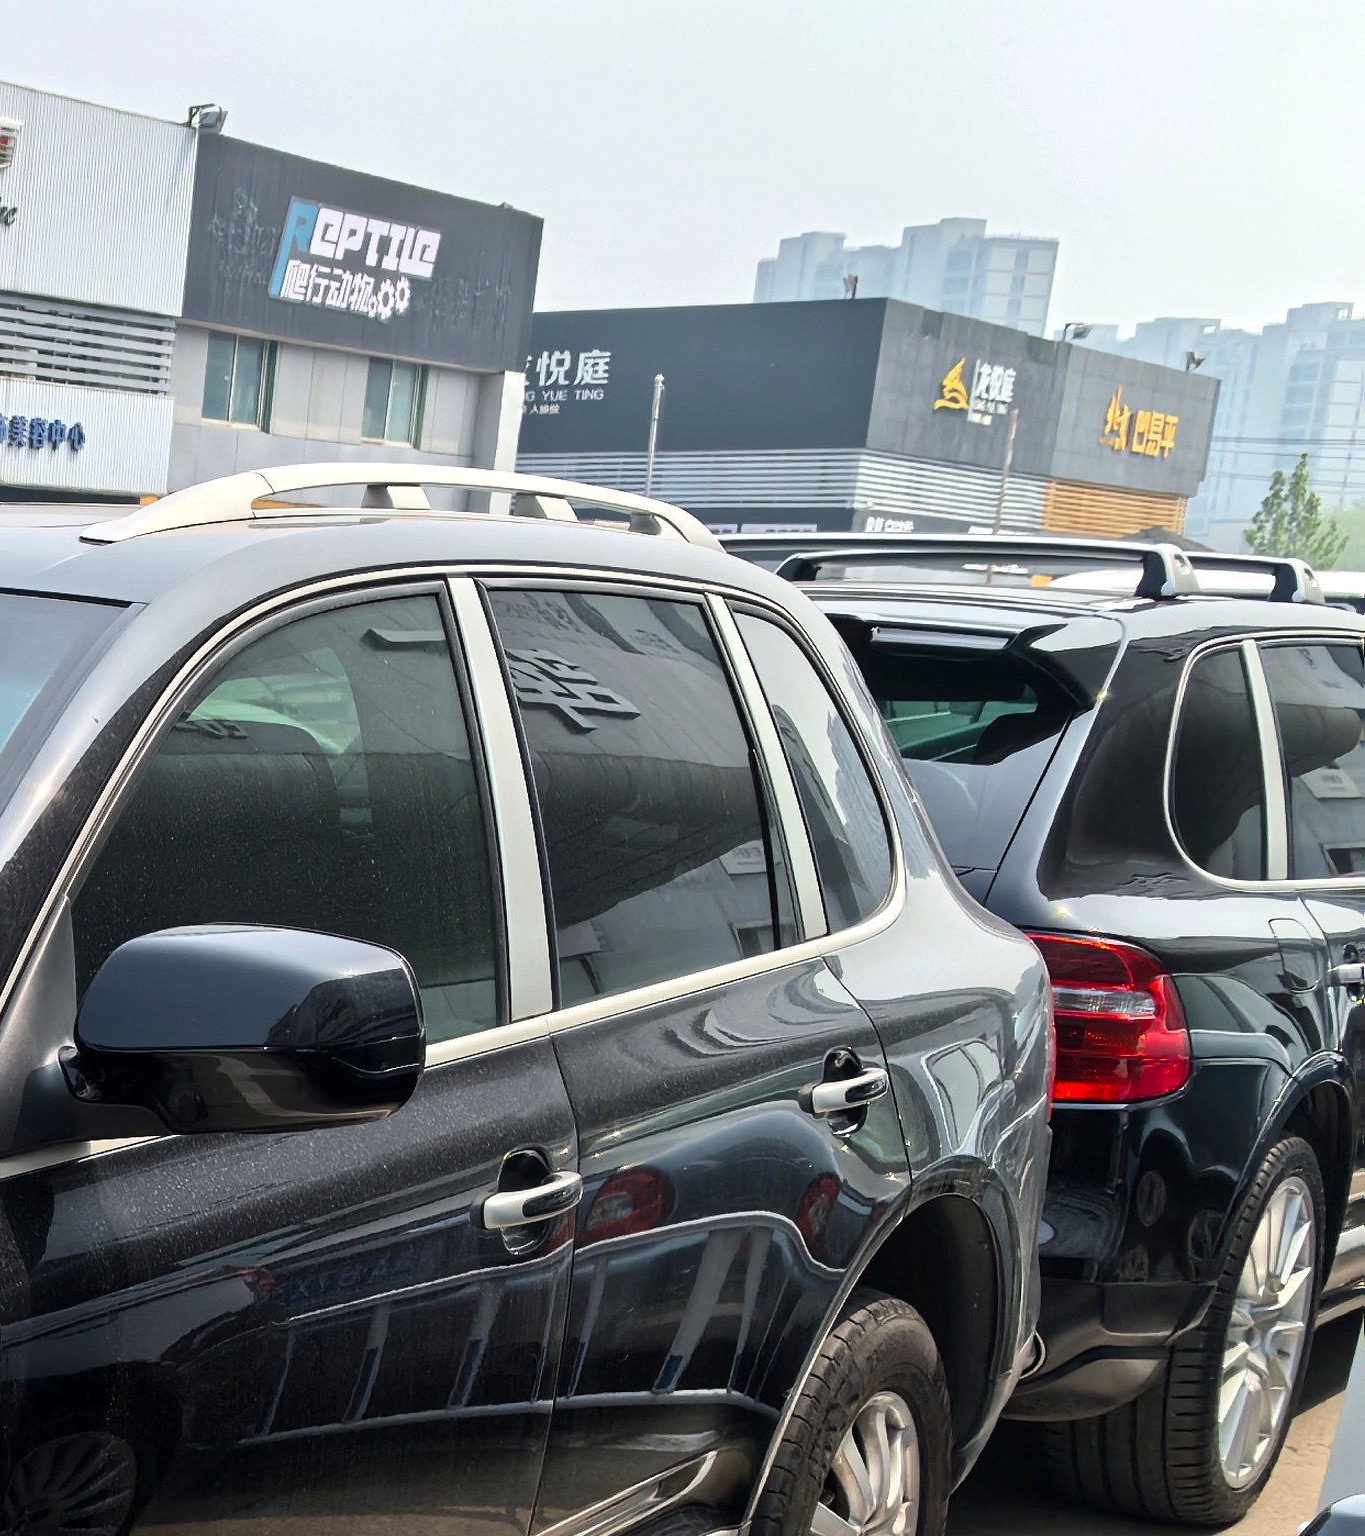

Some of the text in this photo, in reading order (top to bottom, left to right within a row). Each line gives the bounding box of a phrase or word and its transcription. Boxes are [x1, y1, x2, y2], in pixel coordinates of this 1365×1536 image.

[272, 201, 441, 290] REPTILE
[280, 259, 376, 314] 爬行动物
[525, 349, 611, 386] 悦庭
[542, 390, 568, 401] YUE
[574, 388, 605, 401] TING
